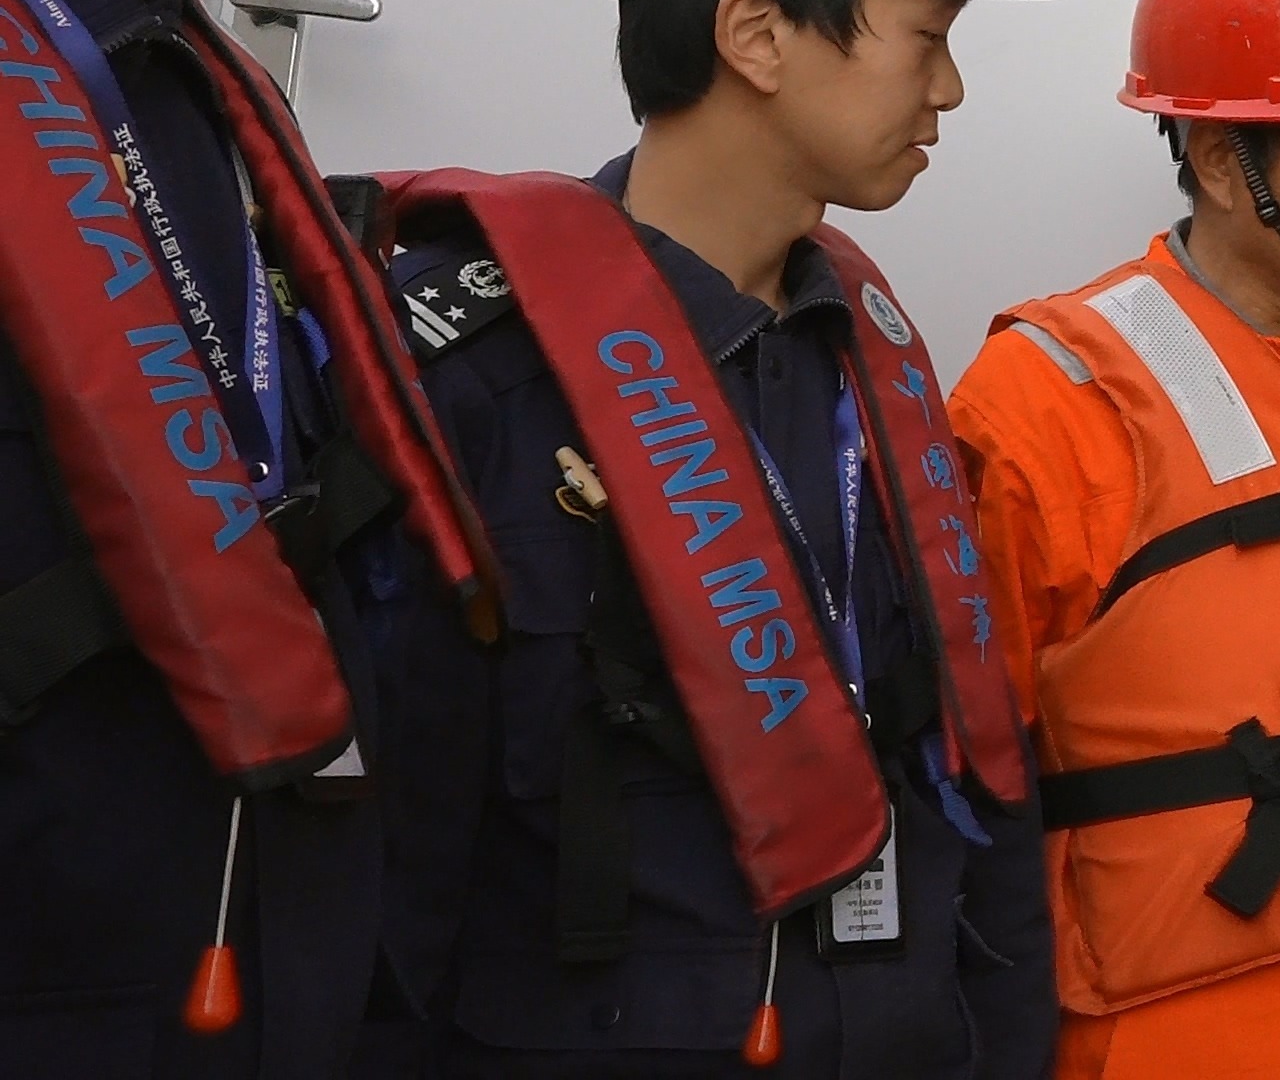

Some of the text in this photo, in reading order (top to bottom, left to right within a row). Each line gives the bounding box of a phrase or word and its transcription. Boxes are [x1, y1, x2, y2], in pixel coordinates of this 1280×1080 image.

[113, 122, 238, 390] 中华人民共和国行政执法证
[125, 323, 262, 554] MSA
[598, 330, 744, 556] CHINA
[700, 556, 809, 734] MSA
